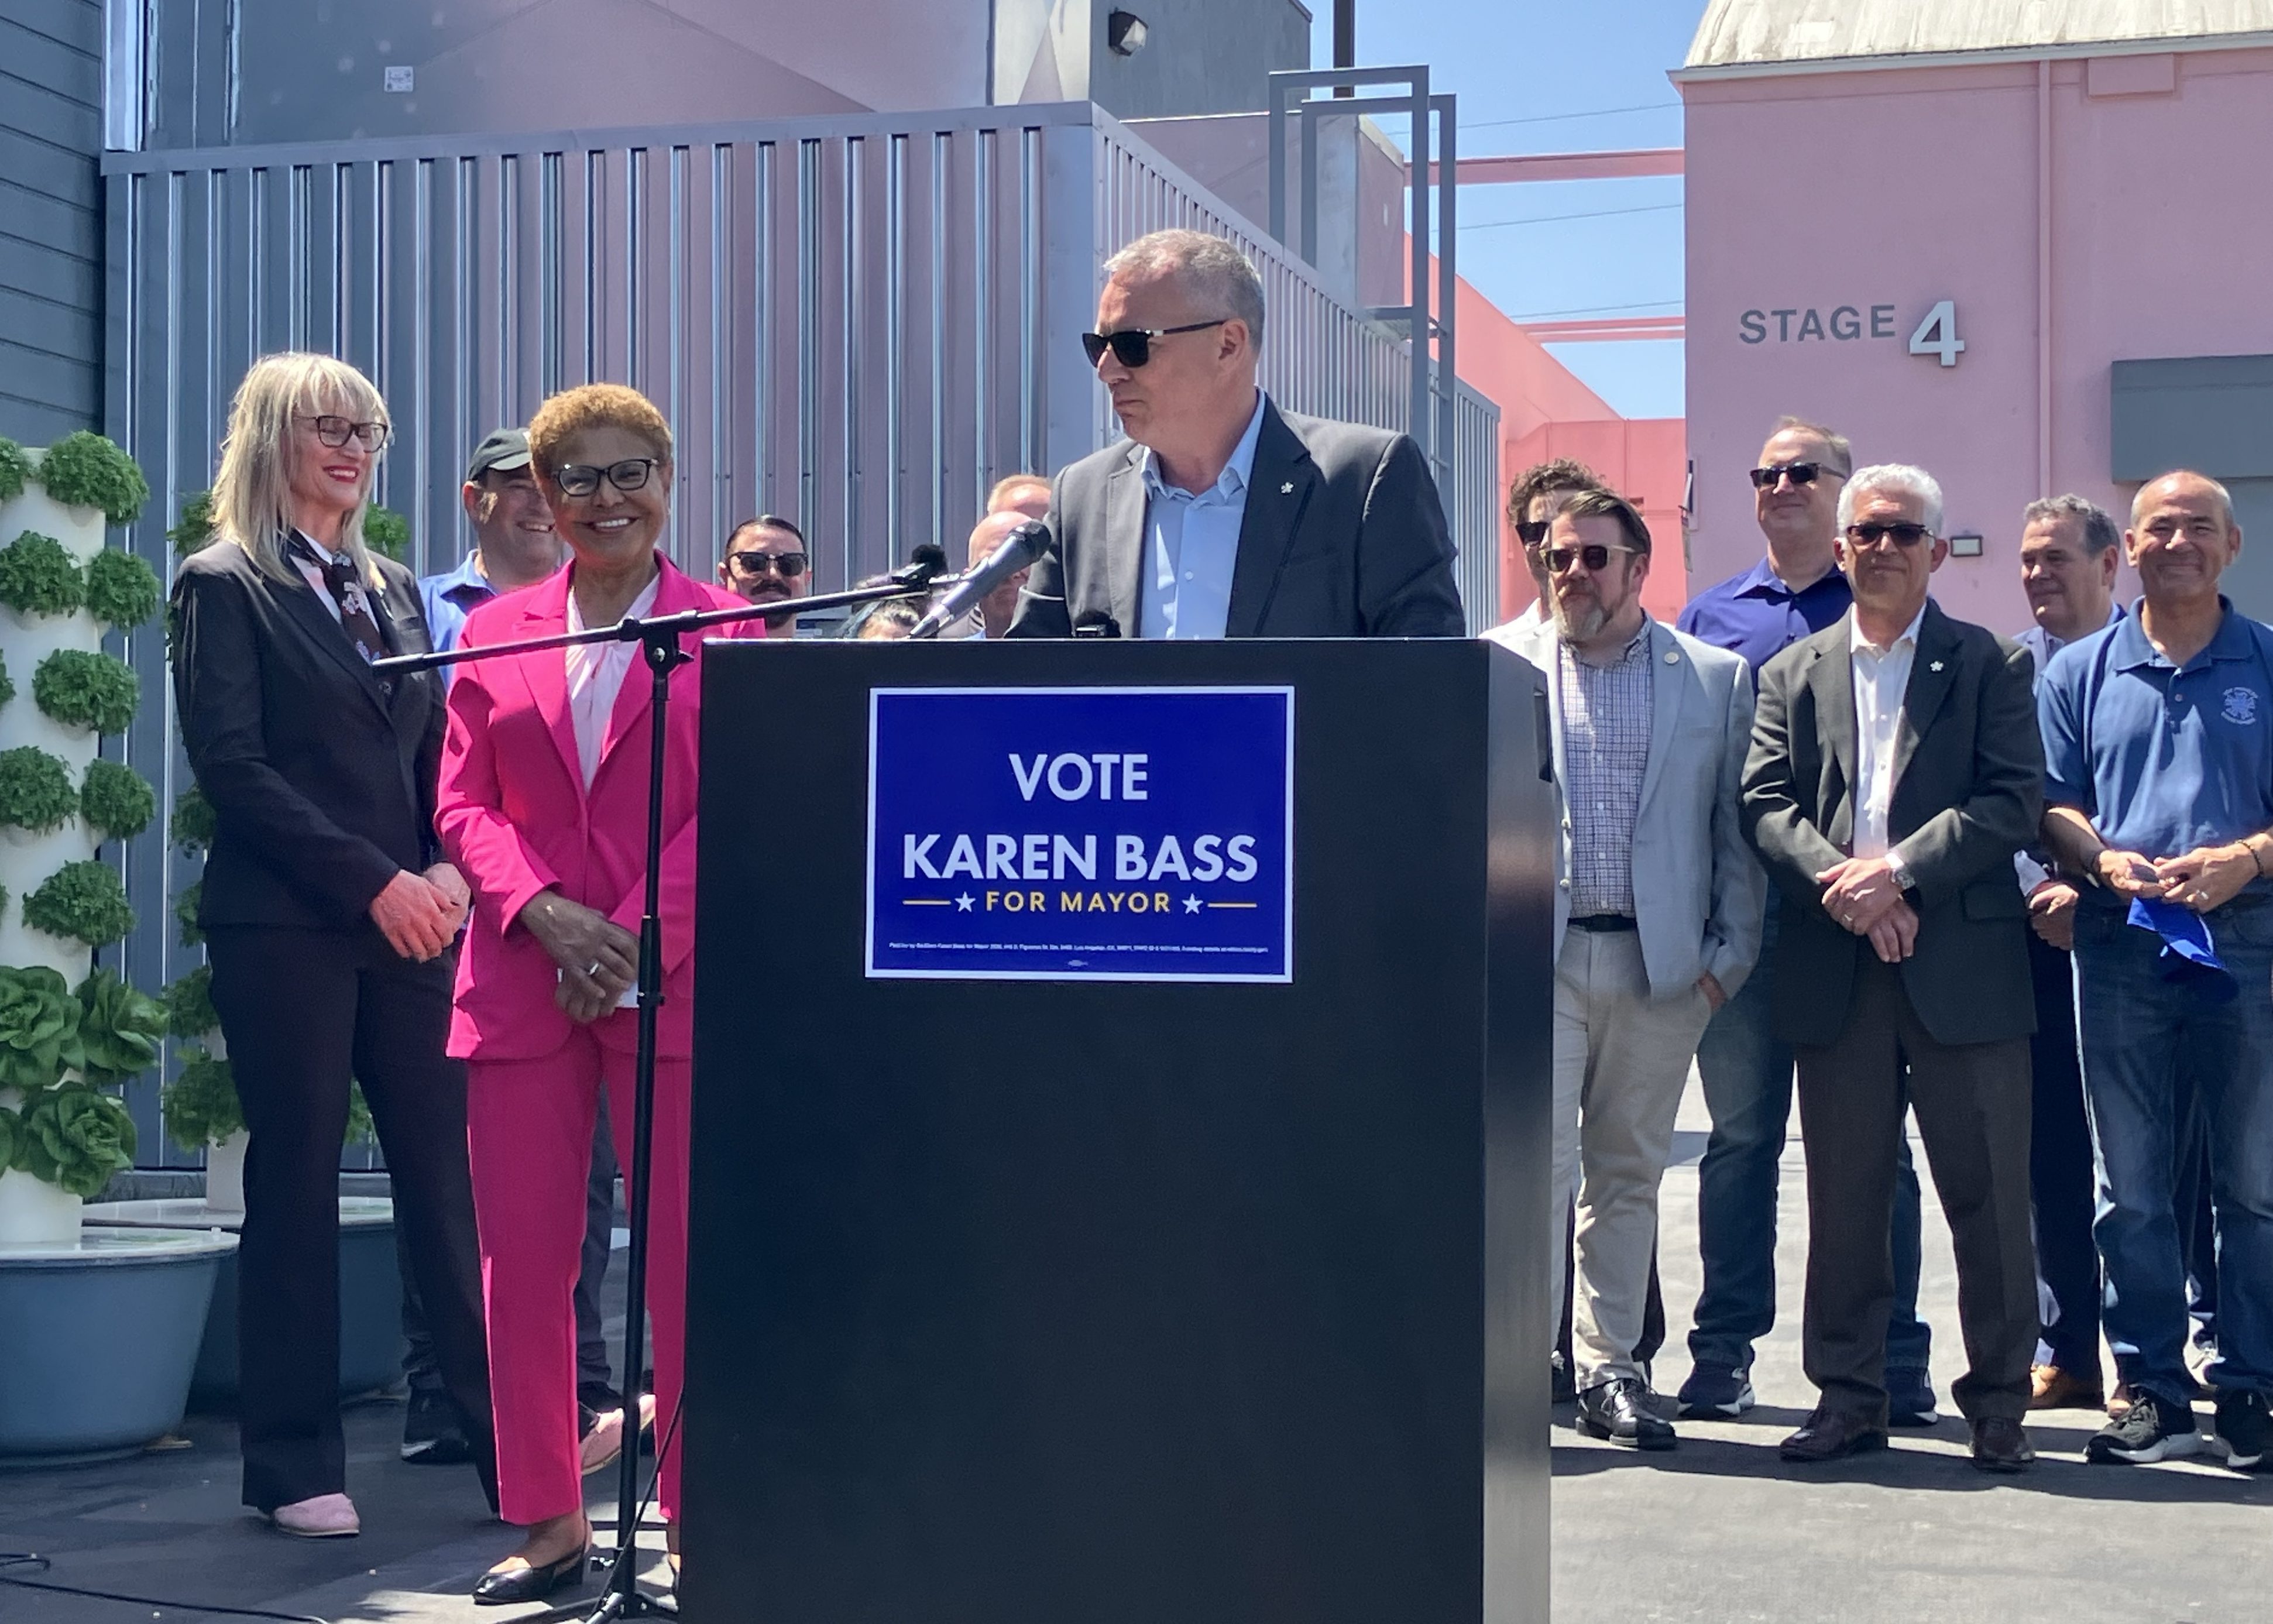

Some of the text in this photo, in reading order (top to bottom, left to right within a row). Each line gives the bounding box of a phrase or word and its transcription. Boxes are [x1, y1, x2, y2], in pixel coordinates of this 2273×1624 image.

[1739, 300, 1965, 367] STAGE 4
[1008, 753, 1148, 801] VOTE
[903, 834, 1258, 882] KAREN BASS
[986, 891, 1170, 913] FOR MAYOR
